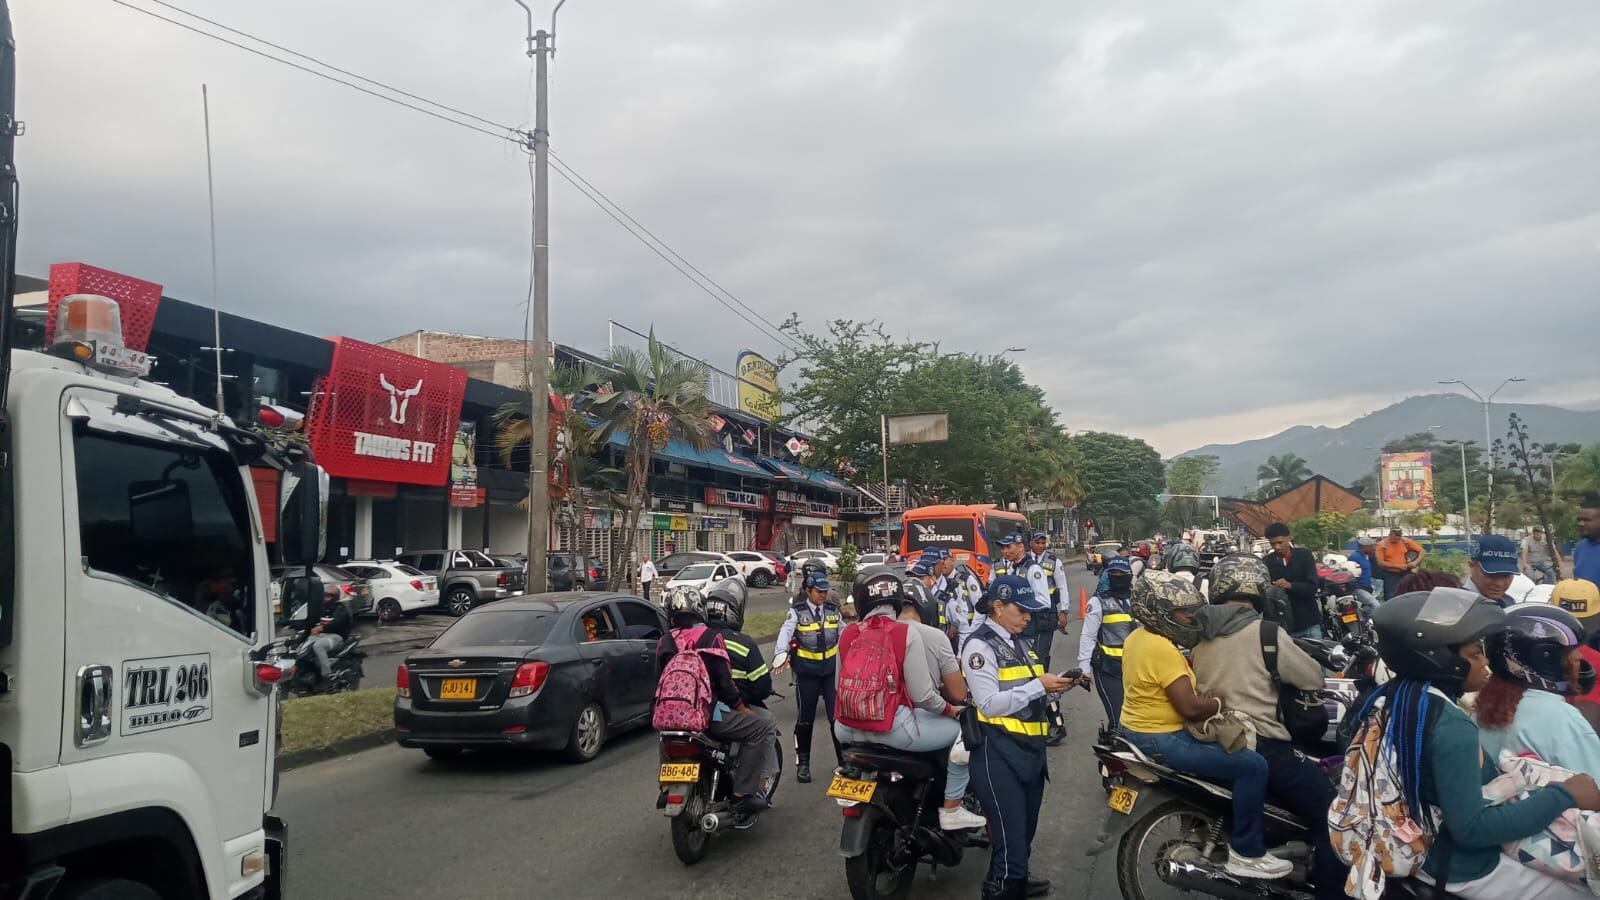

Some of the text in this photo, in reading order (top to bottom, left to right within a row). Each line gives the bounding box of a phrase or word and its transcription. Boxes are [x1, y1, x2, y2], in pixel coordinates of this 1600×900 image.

[354, 431, 436, 463] TAUROS FIT
[124, 663, 209, 709] TRL 266
[442, 681, 474, 693] GJU 141
[129, 709, 182, 728] BELLO
